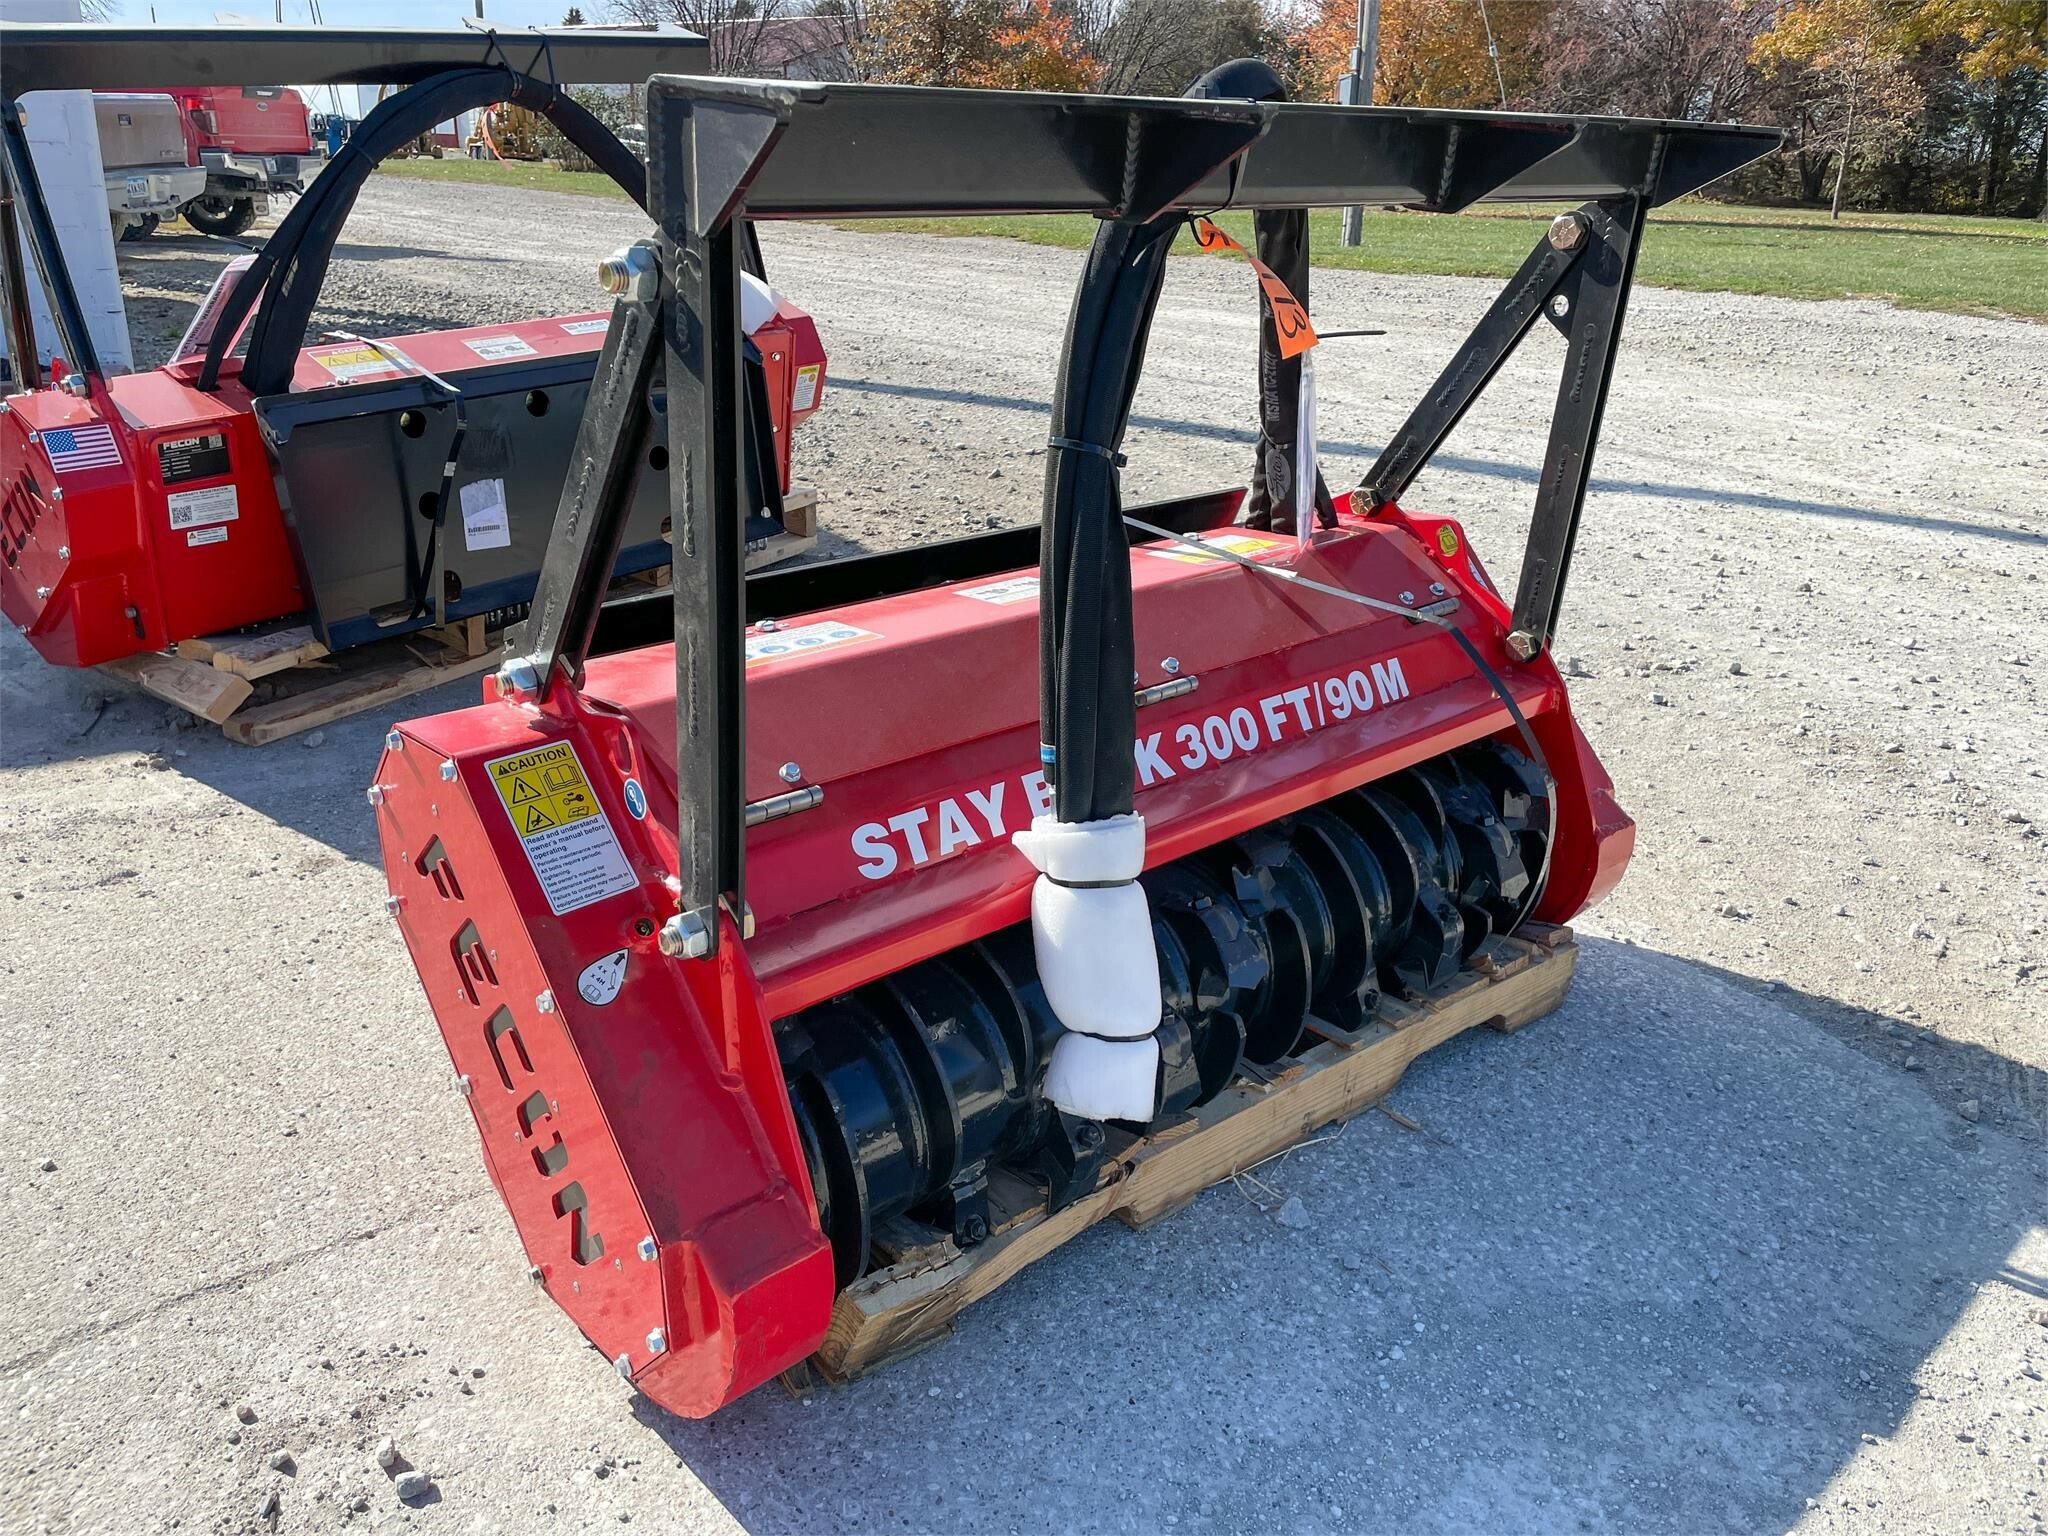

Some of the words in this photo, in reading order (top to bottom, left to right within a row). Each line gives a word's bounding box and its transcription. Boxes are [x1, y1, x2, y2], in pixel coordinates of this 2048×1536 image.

[163, 437, 201, 450] FECON
[508, 747, 567, 773] CAUTION
[851, 781, 1008, 880] STAY
[1022, 732, 1176, 822] BK
[1175, 706, 1260, 771] 300
[526, 835, 545, 845] Read
[546, 830, 560, 839] and
[560, 817, 599, 834] understand
[530, 839, 558, 853] owner's
[558, 831, 584, 843] manual
[584, 824, 606, 835] before
[533, 844, 569, 860] operating.
[536, 856, 559, 868] Periodic
[558, 847, 591, 860] maintenance
[549, 863, 562, 872] bolts
[562, 857, 581, 867] require
[578, 882, 597, 893] comply
[597, 879, 608, 888] may
[556, 896, 584, 909] equipment
[414, 833, 605, 1267] FECON
